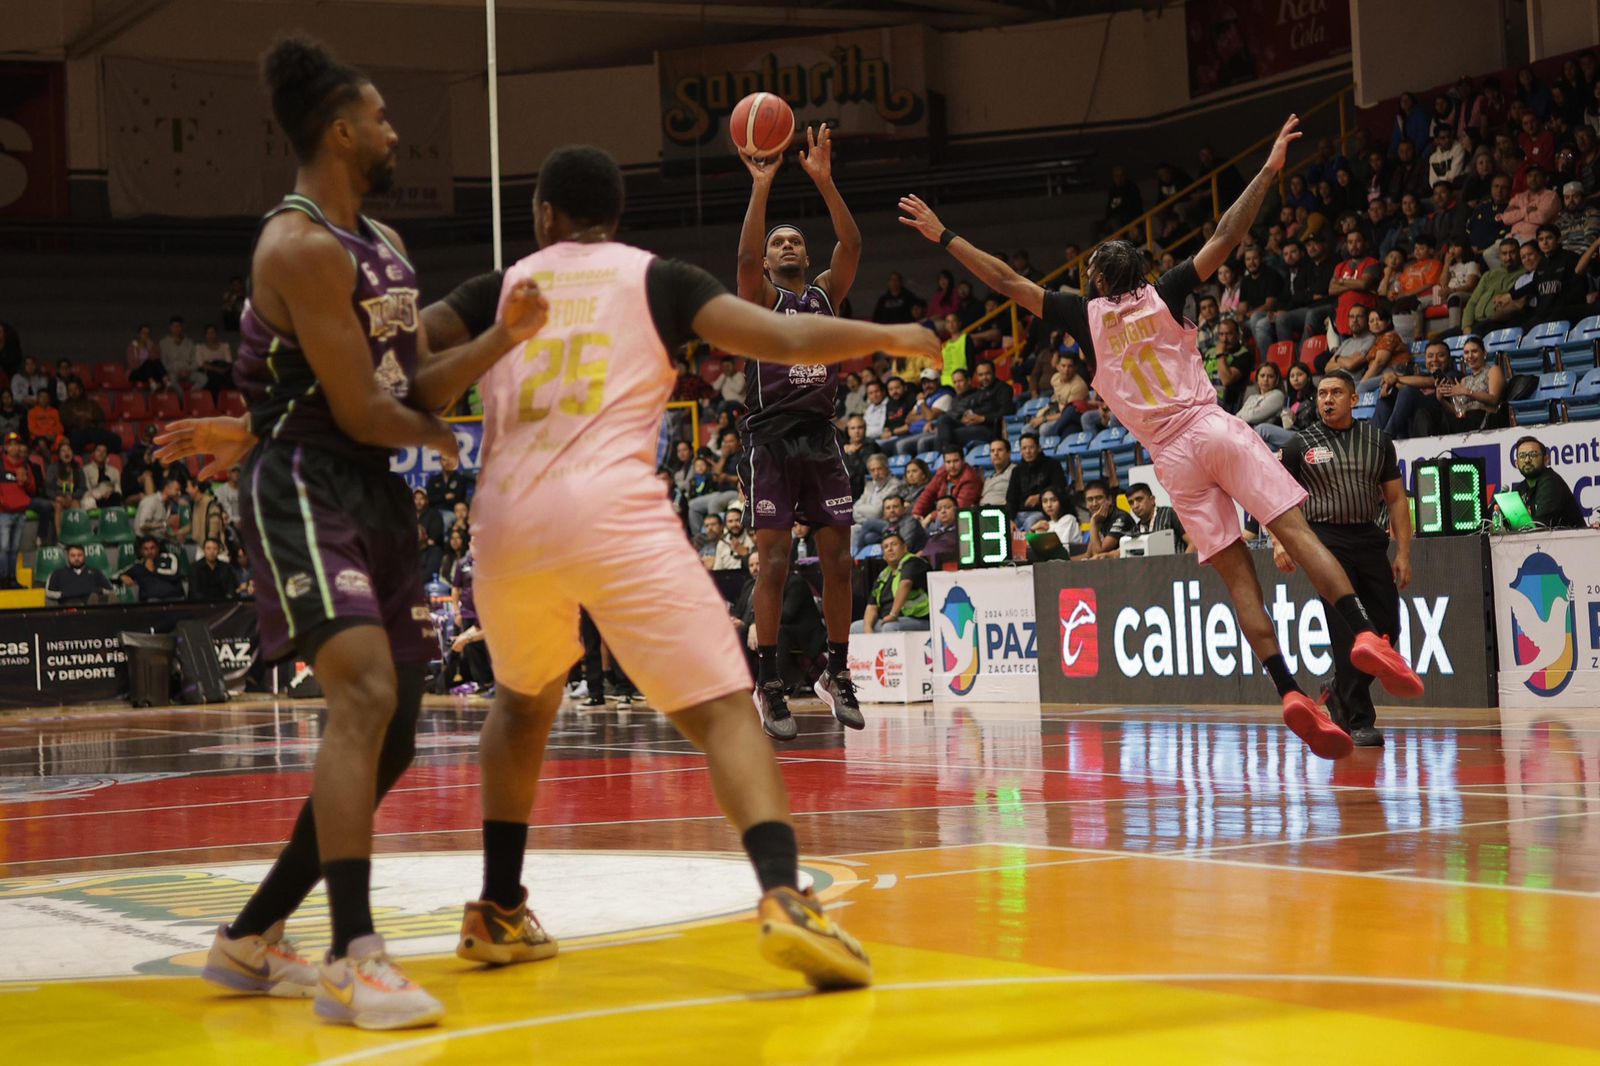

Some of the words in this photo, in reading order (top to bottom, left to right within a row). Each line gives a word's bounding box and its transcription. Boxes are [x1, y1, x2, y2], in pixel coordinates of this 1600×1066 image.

[1290, 16, 1325, 50] Cola
[518, 332, 613, 422] 25
[1120, 343, 1176, 405] 11
[47, 639, 103, 652] INSTITUTO
[105, 638, 120, 648] DE
[214, 643, 252, 662] AZ
[985, 621, 1039, 660] PAZ
[47, 653, 104, 666] CULTURA
[47, 671, 56, 681] Y
[59, 667, 116, 681] DEPORTE
